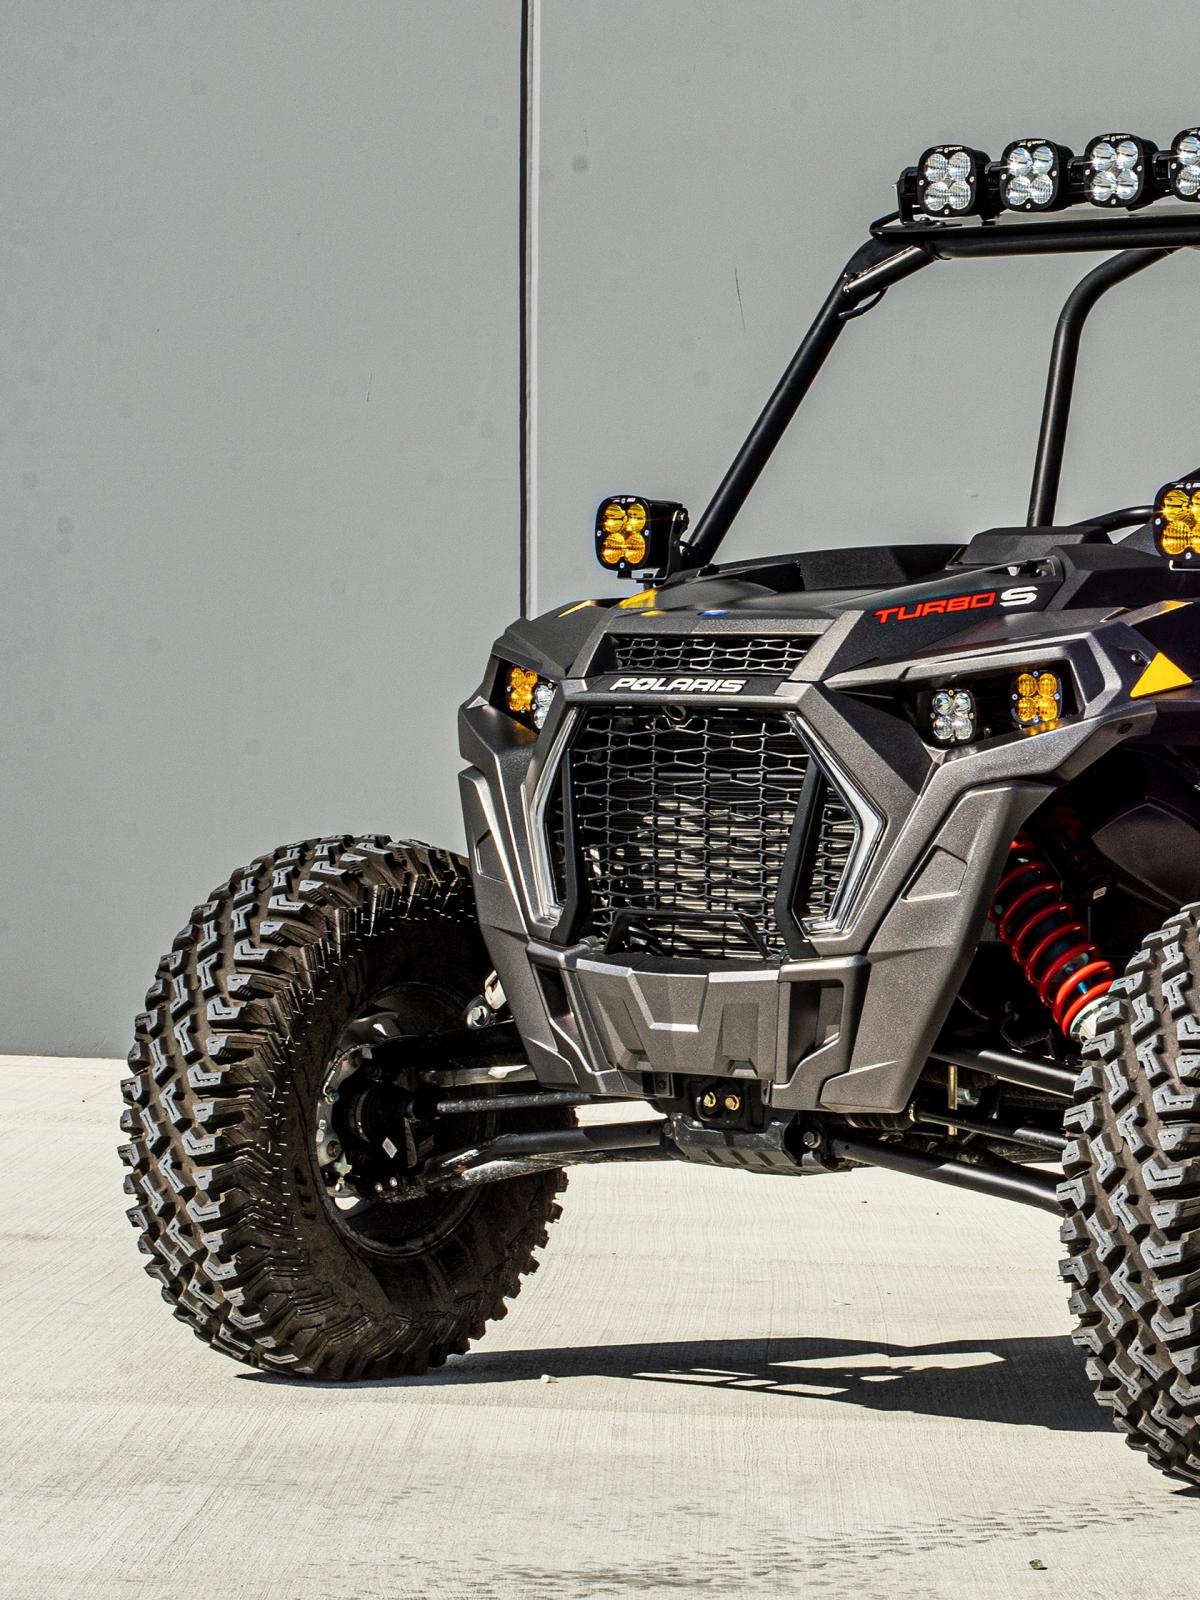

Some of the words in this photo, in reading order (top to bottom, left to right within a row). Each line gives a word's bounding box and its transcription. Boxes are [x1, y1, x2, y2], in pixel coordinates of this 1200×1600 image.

[872, 591, 997, 625] TURBO
[999, 586, 1038, 608] S
[609, 676, 748, 695] POLARIS
